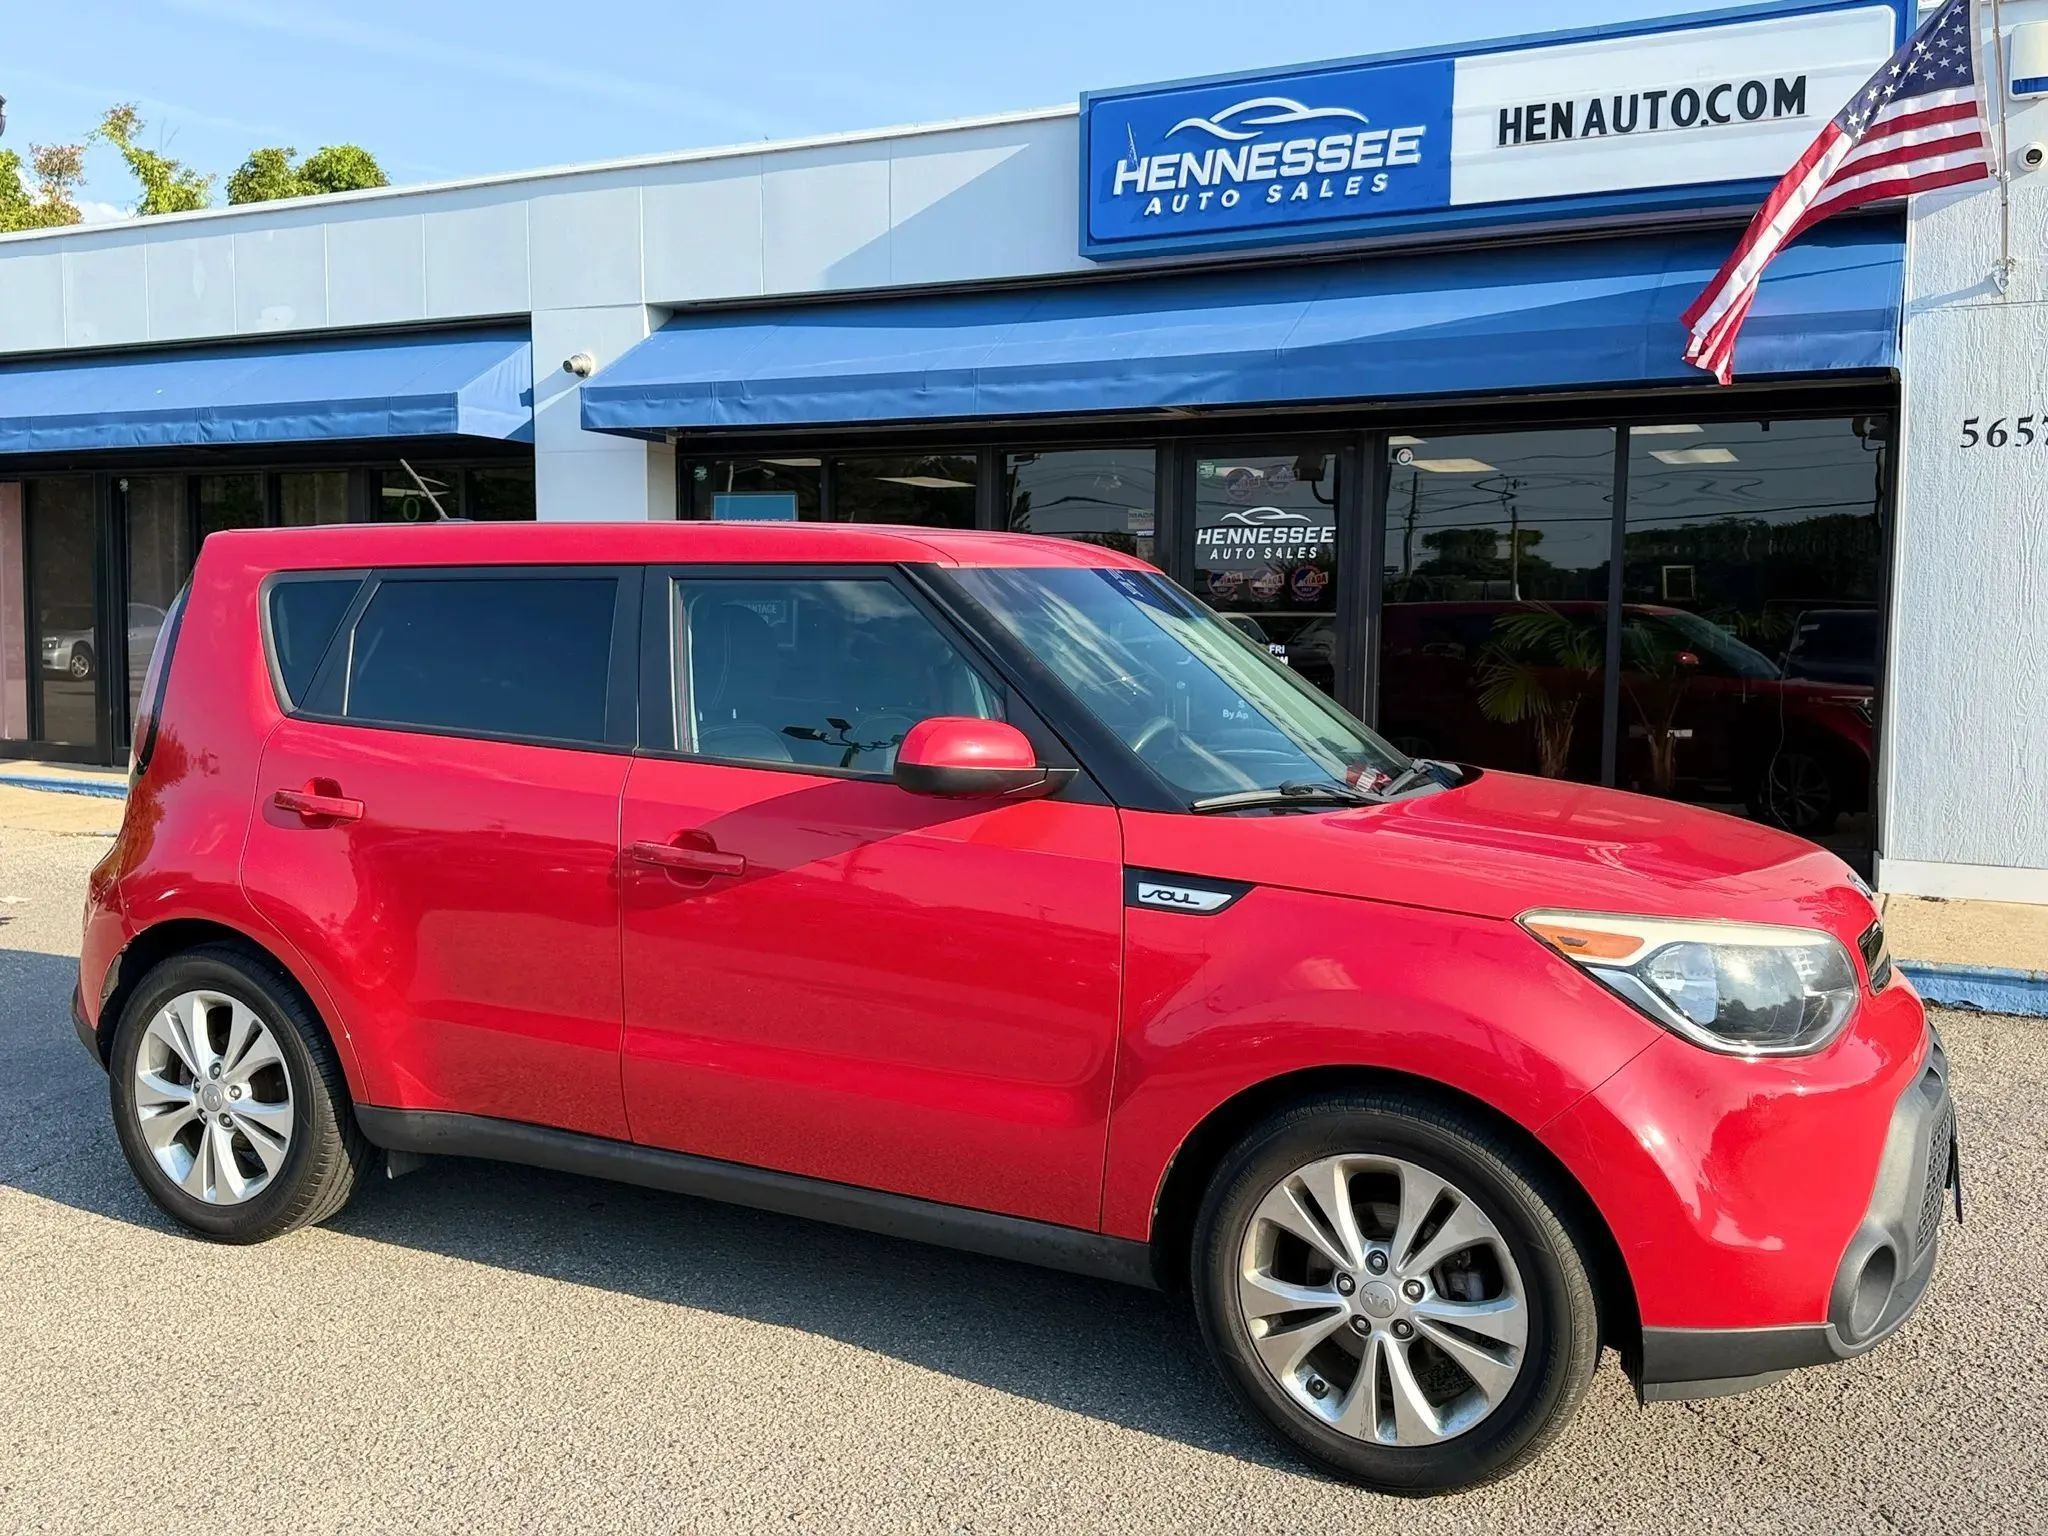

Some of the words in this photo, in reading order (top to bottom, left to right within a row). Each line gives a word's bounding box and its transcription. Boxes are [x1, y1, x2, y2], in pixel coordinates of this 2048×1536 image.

[1112, 125, 1426, 196] HENNESSEE
[1144, 187, 1241, 217] AUTO
[1266, 172, 1389, 204] SALES
[1196, 526, 1336, 545] HENNESSEE
[1209, 548, 1256, 560] AUTO
[1263, 547, 1318, 560] SALES
[1269, 644, 1286, 654] FRI
